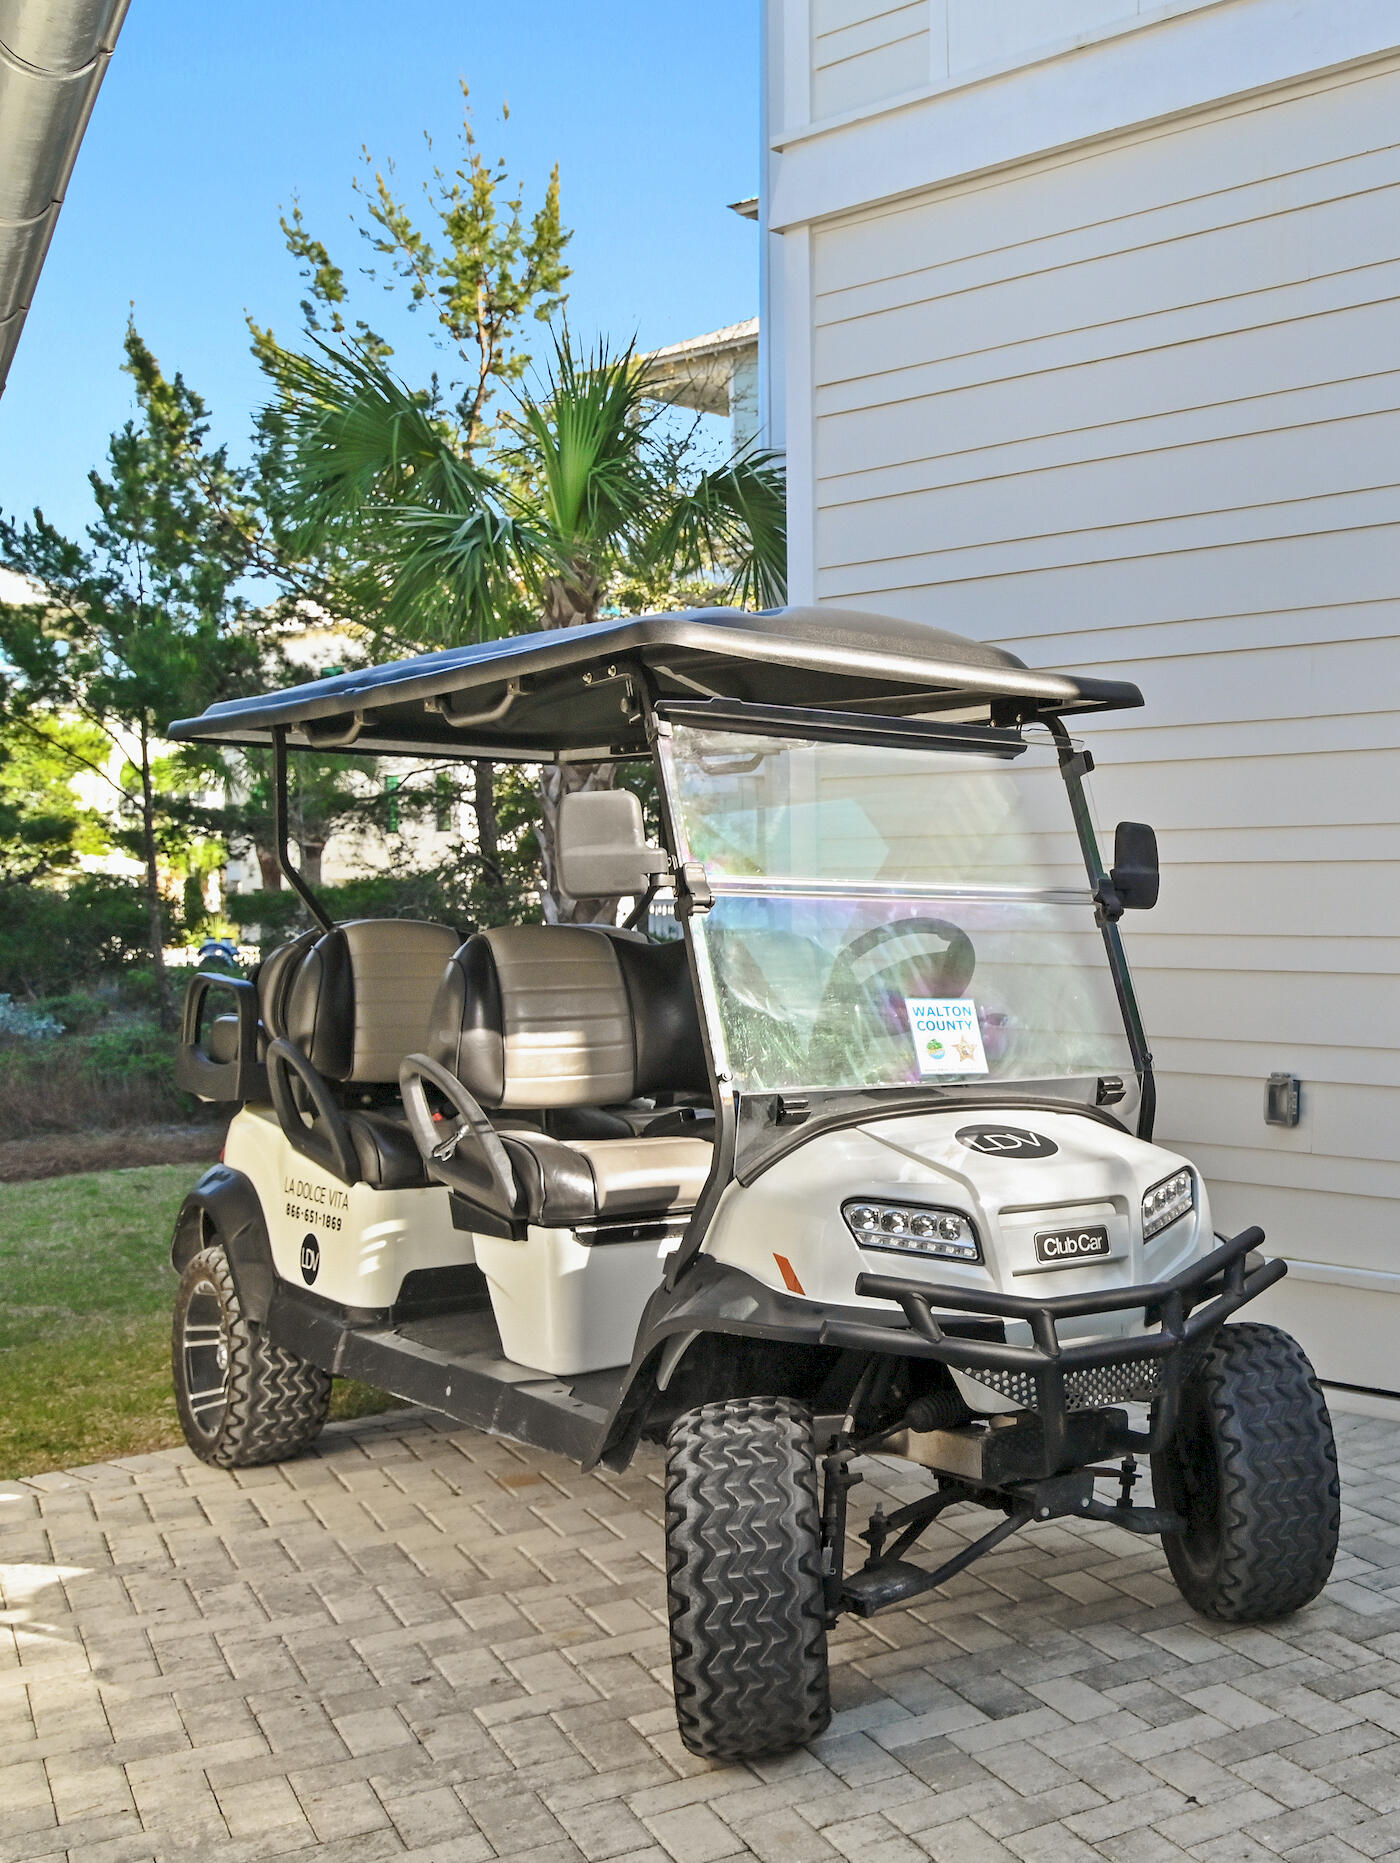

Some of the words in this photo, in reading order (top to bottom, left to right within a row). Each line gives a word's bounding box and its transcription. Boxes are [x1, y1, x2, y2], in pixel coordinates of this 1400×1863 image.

[912, 1006, 972, 1017] WALTON
[917, 1020, 972, 1031] COUNTY
[964, 1132, 1041, 1151] LDV
[284, 1177, 295, 1195] LA
[297, 1180, 326, 1203] DOLCE
[328, 1188, 349, 1210] VITA
[286, 1203, 342, 1231] 866-651-1869
[301, 1247, 319, 1271] LDV
